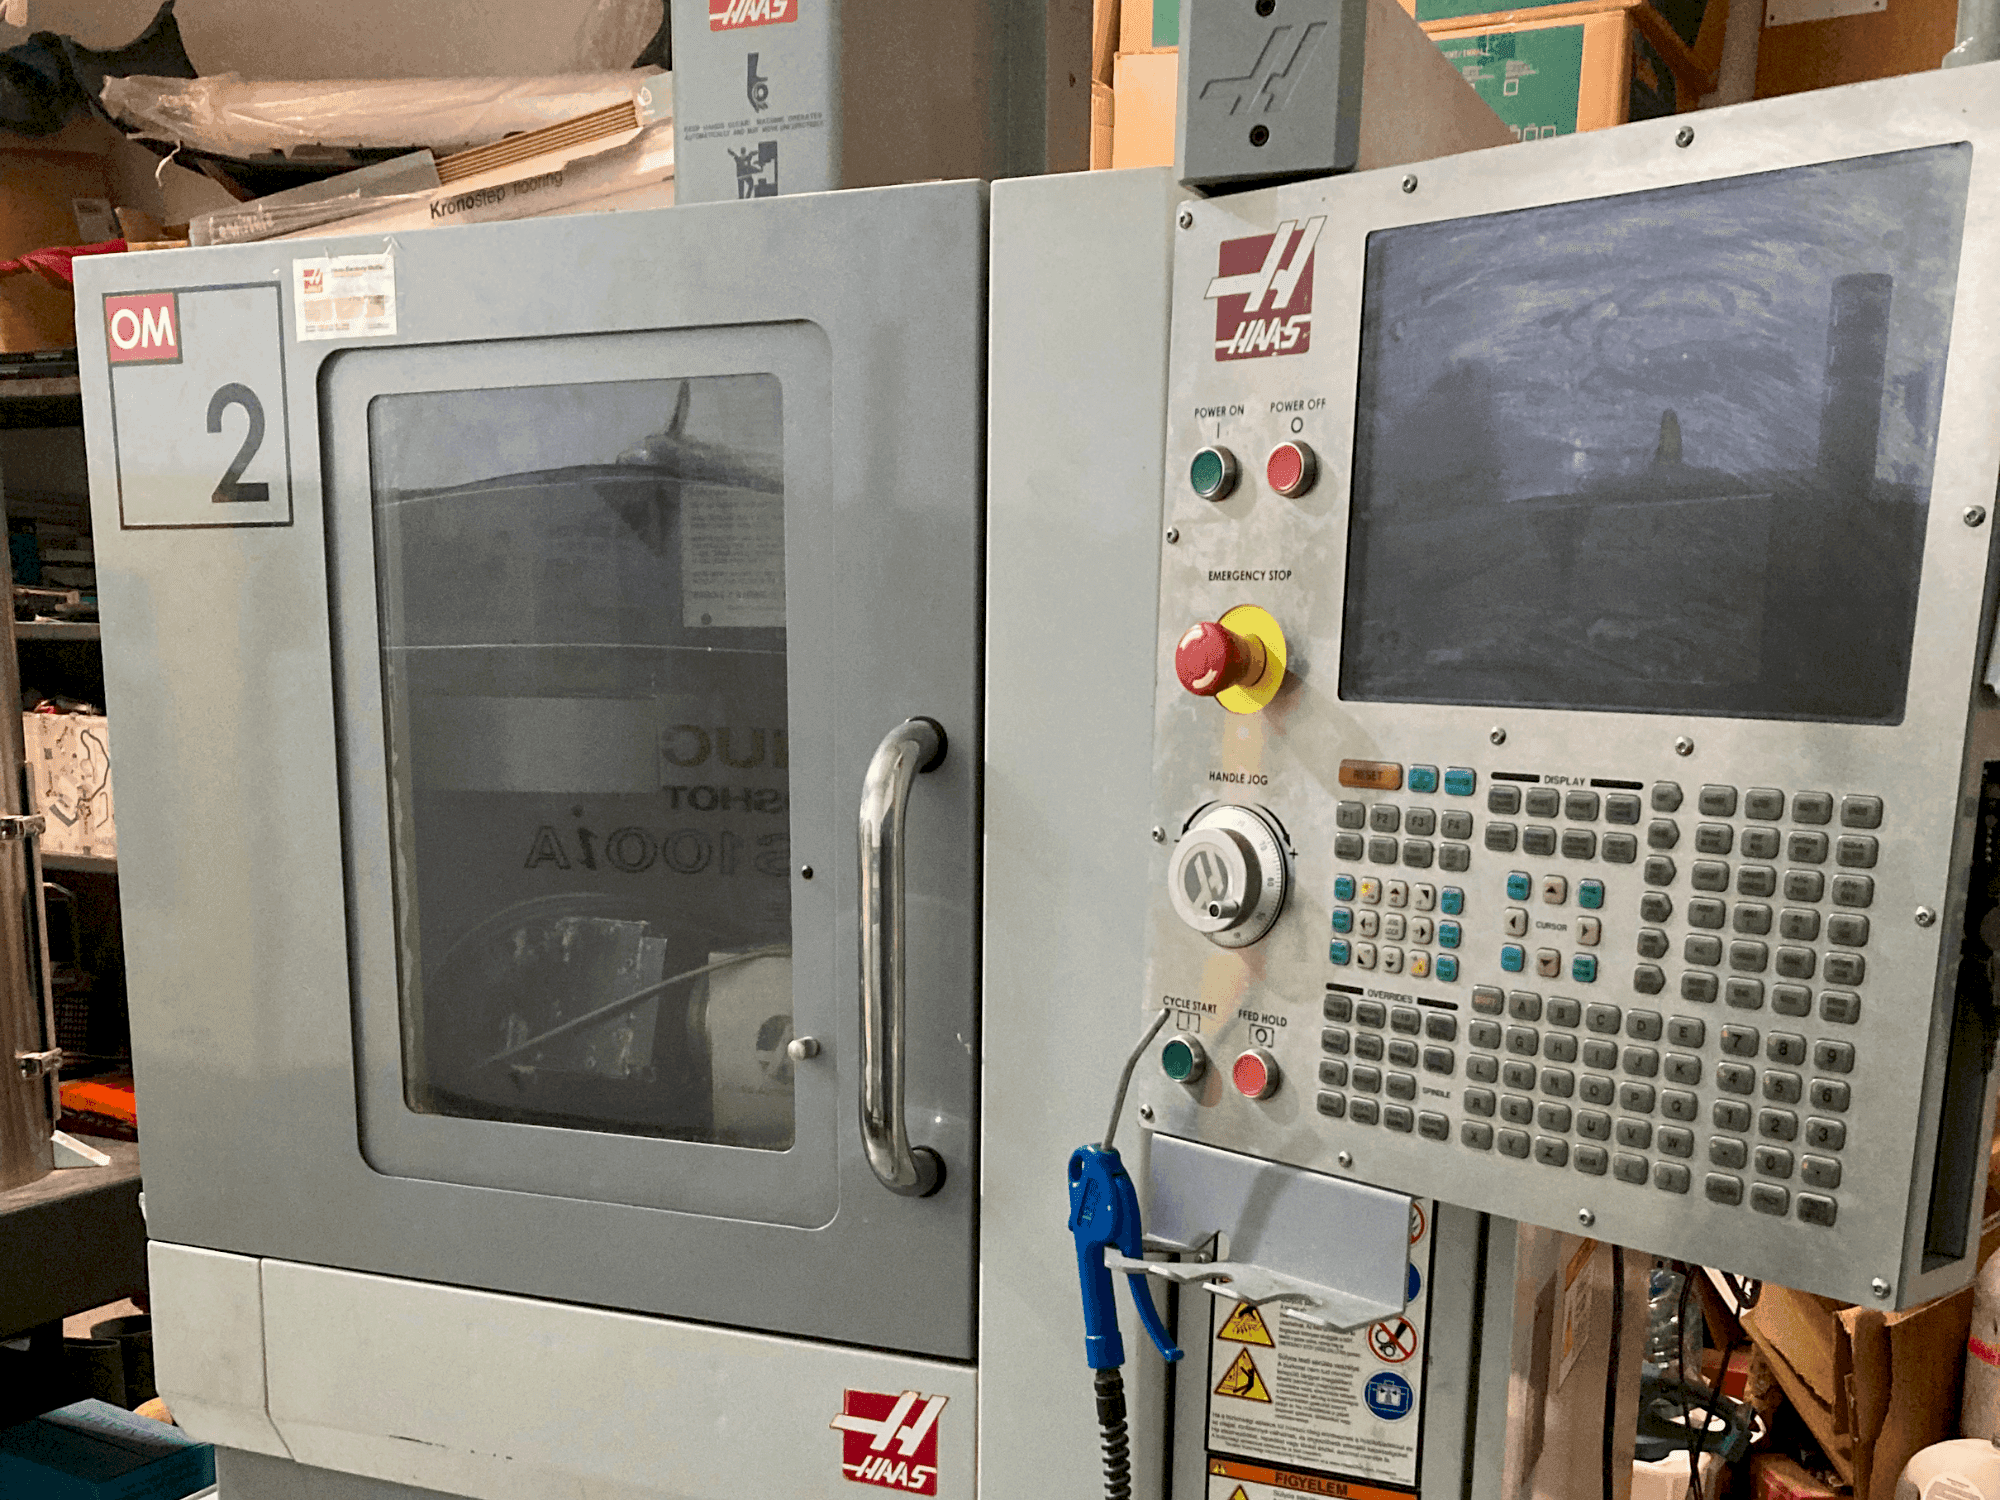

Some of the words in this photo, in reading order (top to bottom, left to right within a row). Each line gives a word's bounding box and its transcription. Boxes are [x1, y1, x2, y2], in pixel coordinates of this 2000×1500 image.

[709, 0, 789, 25] HAAS
[430, 185, 506, 219] Kronostep
[111, 306, 176, 350] OM
[1215, 313, 1312, 354] HAAS
[1194, 406, 1226, 419] POWER
[1229, 404, 1245, 416] ON
[1270, 400, 1304, 413] POWER
[1307, 397, 1327, 410] OFF
[206, 382, 270, 503] 2
[1208, 570, 1266, 582] EMERGENCY
[1269, 570, 1292, 582] STOP
[1209, 771, 1246, 784] HANDLE
[1248, 774, 1269, 785] JOG
[1353, 769, 1383, 781] RESET
[1544, 774, 1586, 787] DISPLAY
[1342, 810, 1353, 820] F1
[1376, 812, 1388, 824] F2
[1412, 816, 1424, 828] F3
[1447, 819, 1460, 830] F4
[1535, 921, 1567, 931] CURSOR
[1367, 989, 1413, 1004] OVERRIDES
[1163, 995, 1190, 1009] CYCLE
[1193, 1002, 1217, 1014] START
[1518, 1002, 1526, 1012] A
[1238, 1009, 1259, 1022] FEED
[1261, 1014, 1288, 1027] HOLD
[1596, 1014, 1605, 1026] C
[1637, 1020, 1646, 1032] D
[1679, 1026, 1688, 1038] E
[1479, 1030, 1487, 1041] F
[1732, 1033, 1742, 1048] 7
[1515, 1036, 1524, 1049] G
[1554, 1042, 1562, 1053] H
[1778, 1041, 1788, 1056] 8
[1827, 1048, 1837, 1063] 9
[1634, 1057, 1642, 1068] J
[1476, 1064, 1483, 1075] L
[1675, 1063, 1684, 1076] K
[1512, 1071, 1522, 1082] M
[1551, 1077, 1559, 1089] N
[1728, 1071, 1738, 1084] 4
[1422, 1087, 1451, 1099] SPINDLE
[1590, 1084, 1599, 1096] O
[1774, 1079, 1784, 1094] 5
[1631, 1091, 1639, 1103] P
[1821, 1088, 1832, 1103] 6
[1473, 1098, 1481, 1109] R
[1672, 1100, 1682, 1113] Q
[1548, 1112, 1556, 1123] T
[1726, 1109, 1733, 1124] 1
[1587, 1119, 1596, 1132] U
[1771, 1118, 1780, 1133] 2
[1470, 1130, 1478, 1142] X
[1627, 1127, 1636, 1139] V
[1818, 1127, 1828, 1142] 3
[1507, 1138, 1515, 1149] Y
[1544, 1146, 1553, 1157] Z
[1765, 1156, 1775, 1170] 0
[842, 1455, 938, 1489] HAAS
[1275, 1471, 1349, 1496] FIGYELEM
